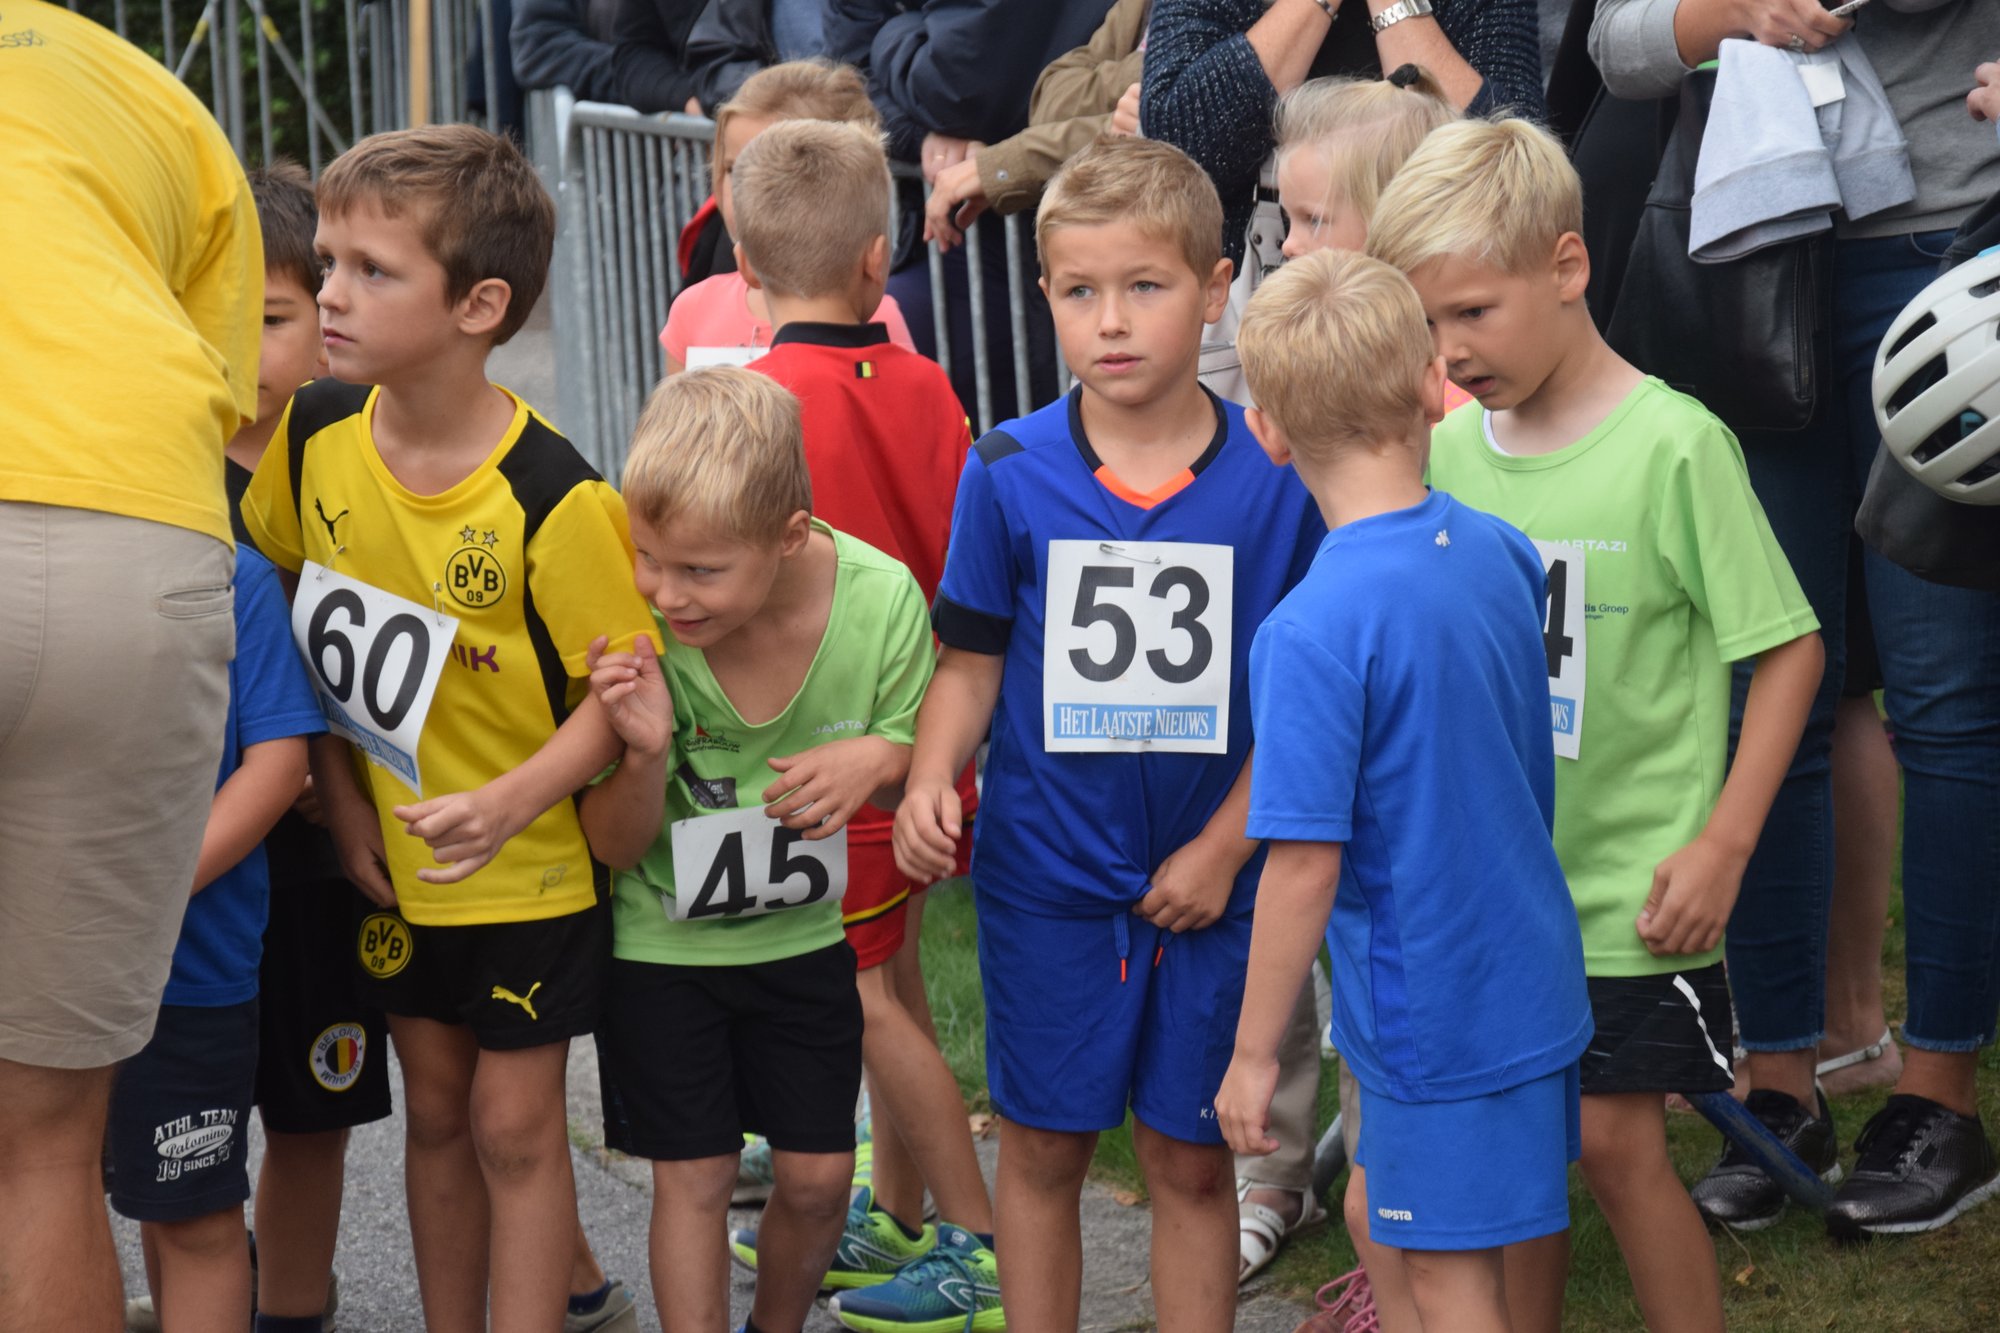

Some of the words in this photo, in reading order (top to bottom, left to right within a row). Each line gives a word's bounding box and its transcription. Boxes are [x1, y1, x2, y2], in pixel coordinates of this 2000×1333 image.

[454, 554, 498, 592] BVB
[466, 590, 484, 603] 09
[1599, 603, 1629, 615] Groep
[1068, 565, 1213, 684] 53
[308, 588, 430, 732] 60
[811, 719, 868, 736] JARTA
[1060, 706, 1089, 735] HET
[1091, 707, 1152, 736] LAATSTE
[1154, 708, 1209, 737] NIEUWS
[687, 820, 830, 919] 45
[365, 921, 404, 960] BVB
[317, 1026, 361, 1052] BELGIUM
[200, 1109, 238, 1127] TEAM
[1200, 1107, 1219, 1119] KI
[165, 1127, 231, 1158] Palomino
[156, 1159, 182, 1182] 19
[184, 1153, 216, 1172] SINCE
